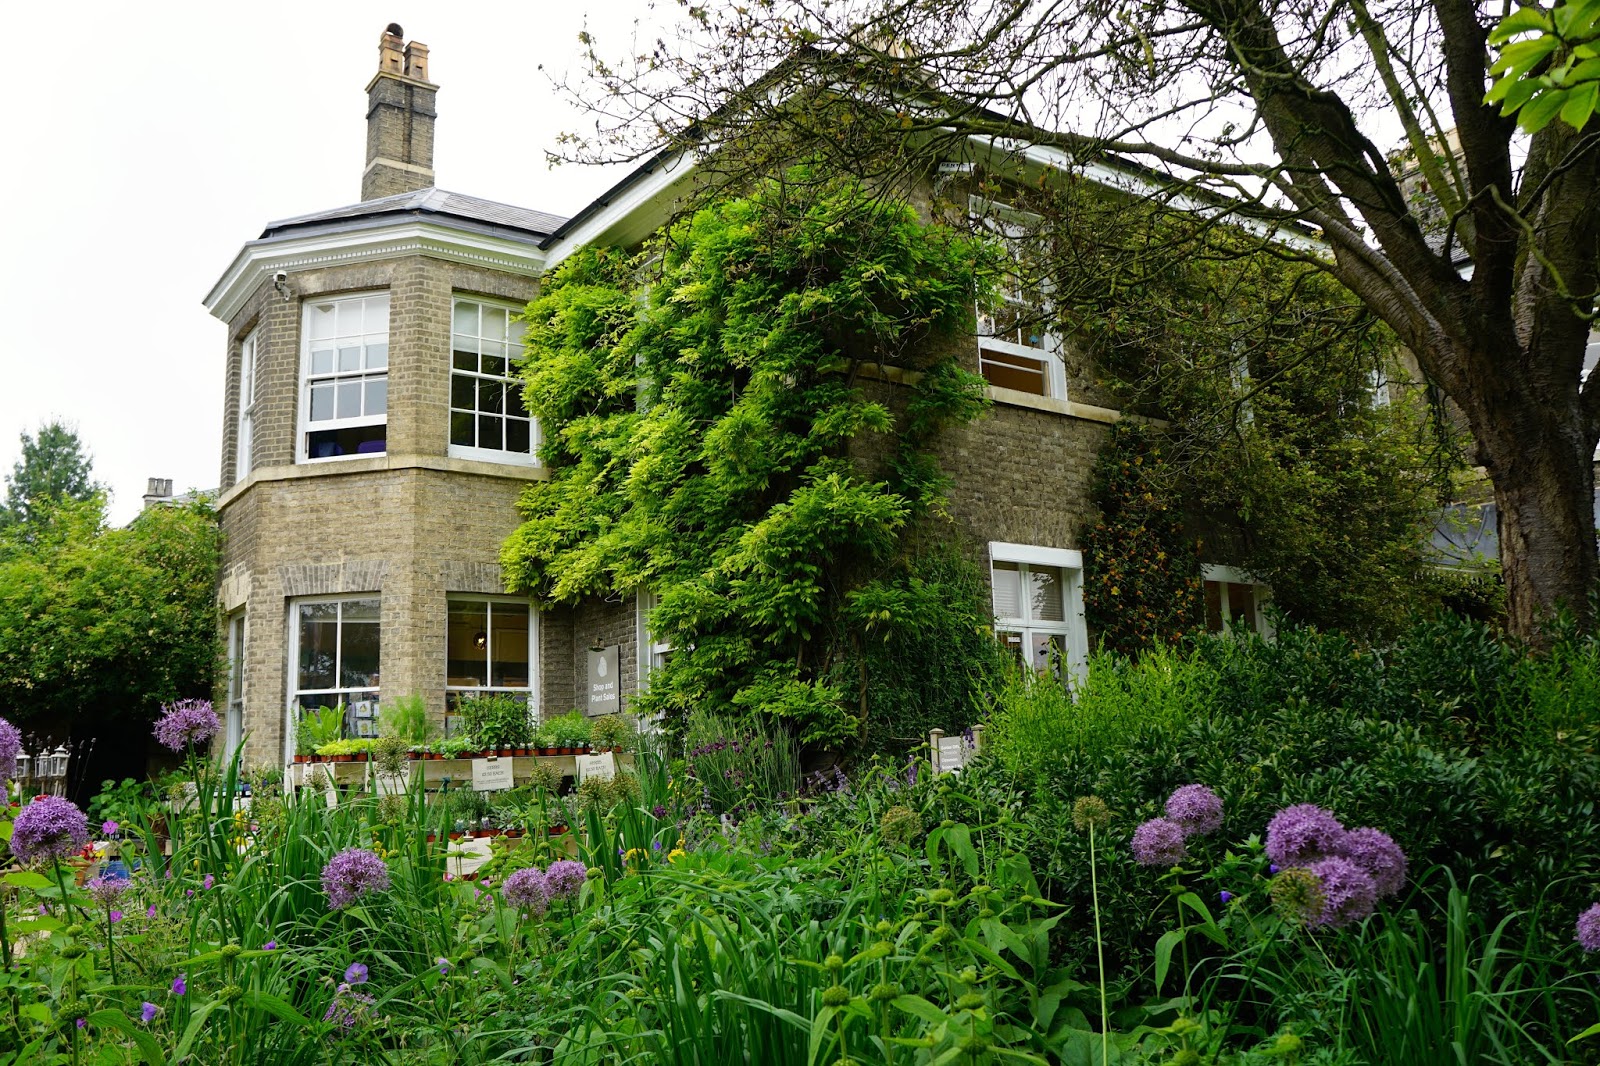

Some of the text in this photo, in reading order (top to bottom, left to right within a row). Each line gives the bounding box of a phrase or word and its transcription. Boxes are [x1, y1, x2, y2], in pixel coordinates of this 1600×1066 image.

[592, 681, 614, 692] Shop and
[592, 692, 616, 703] Plant Sales
